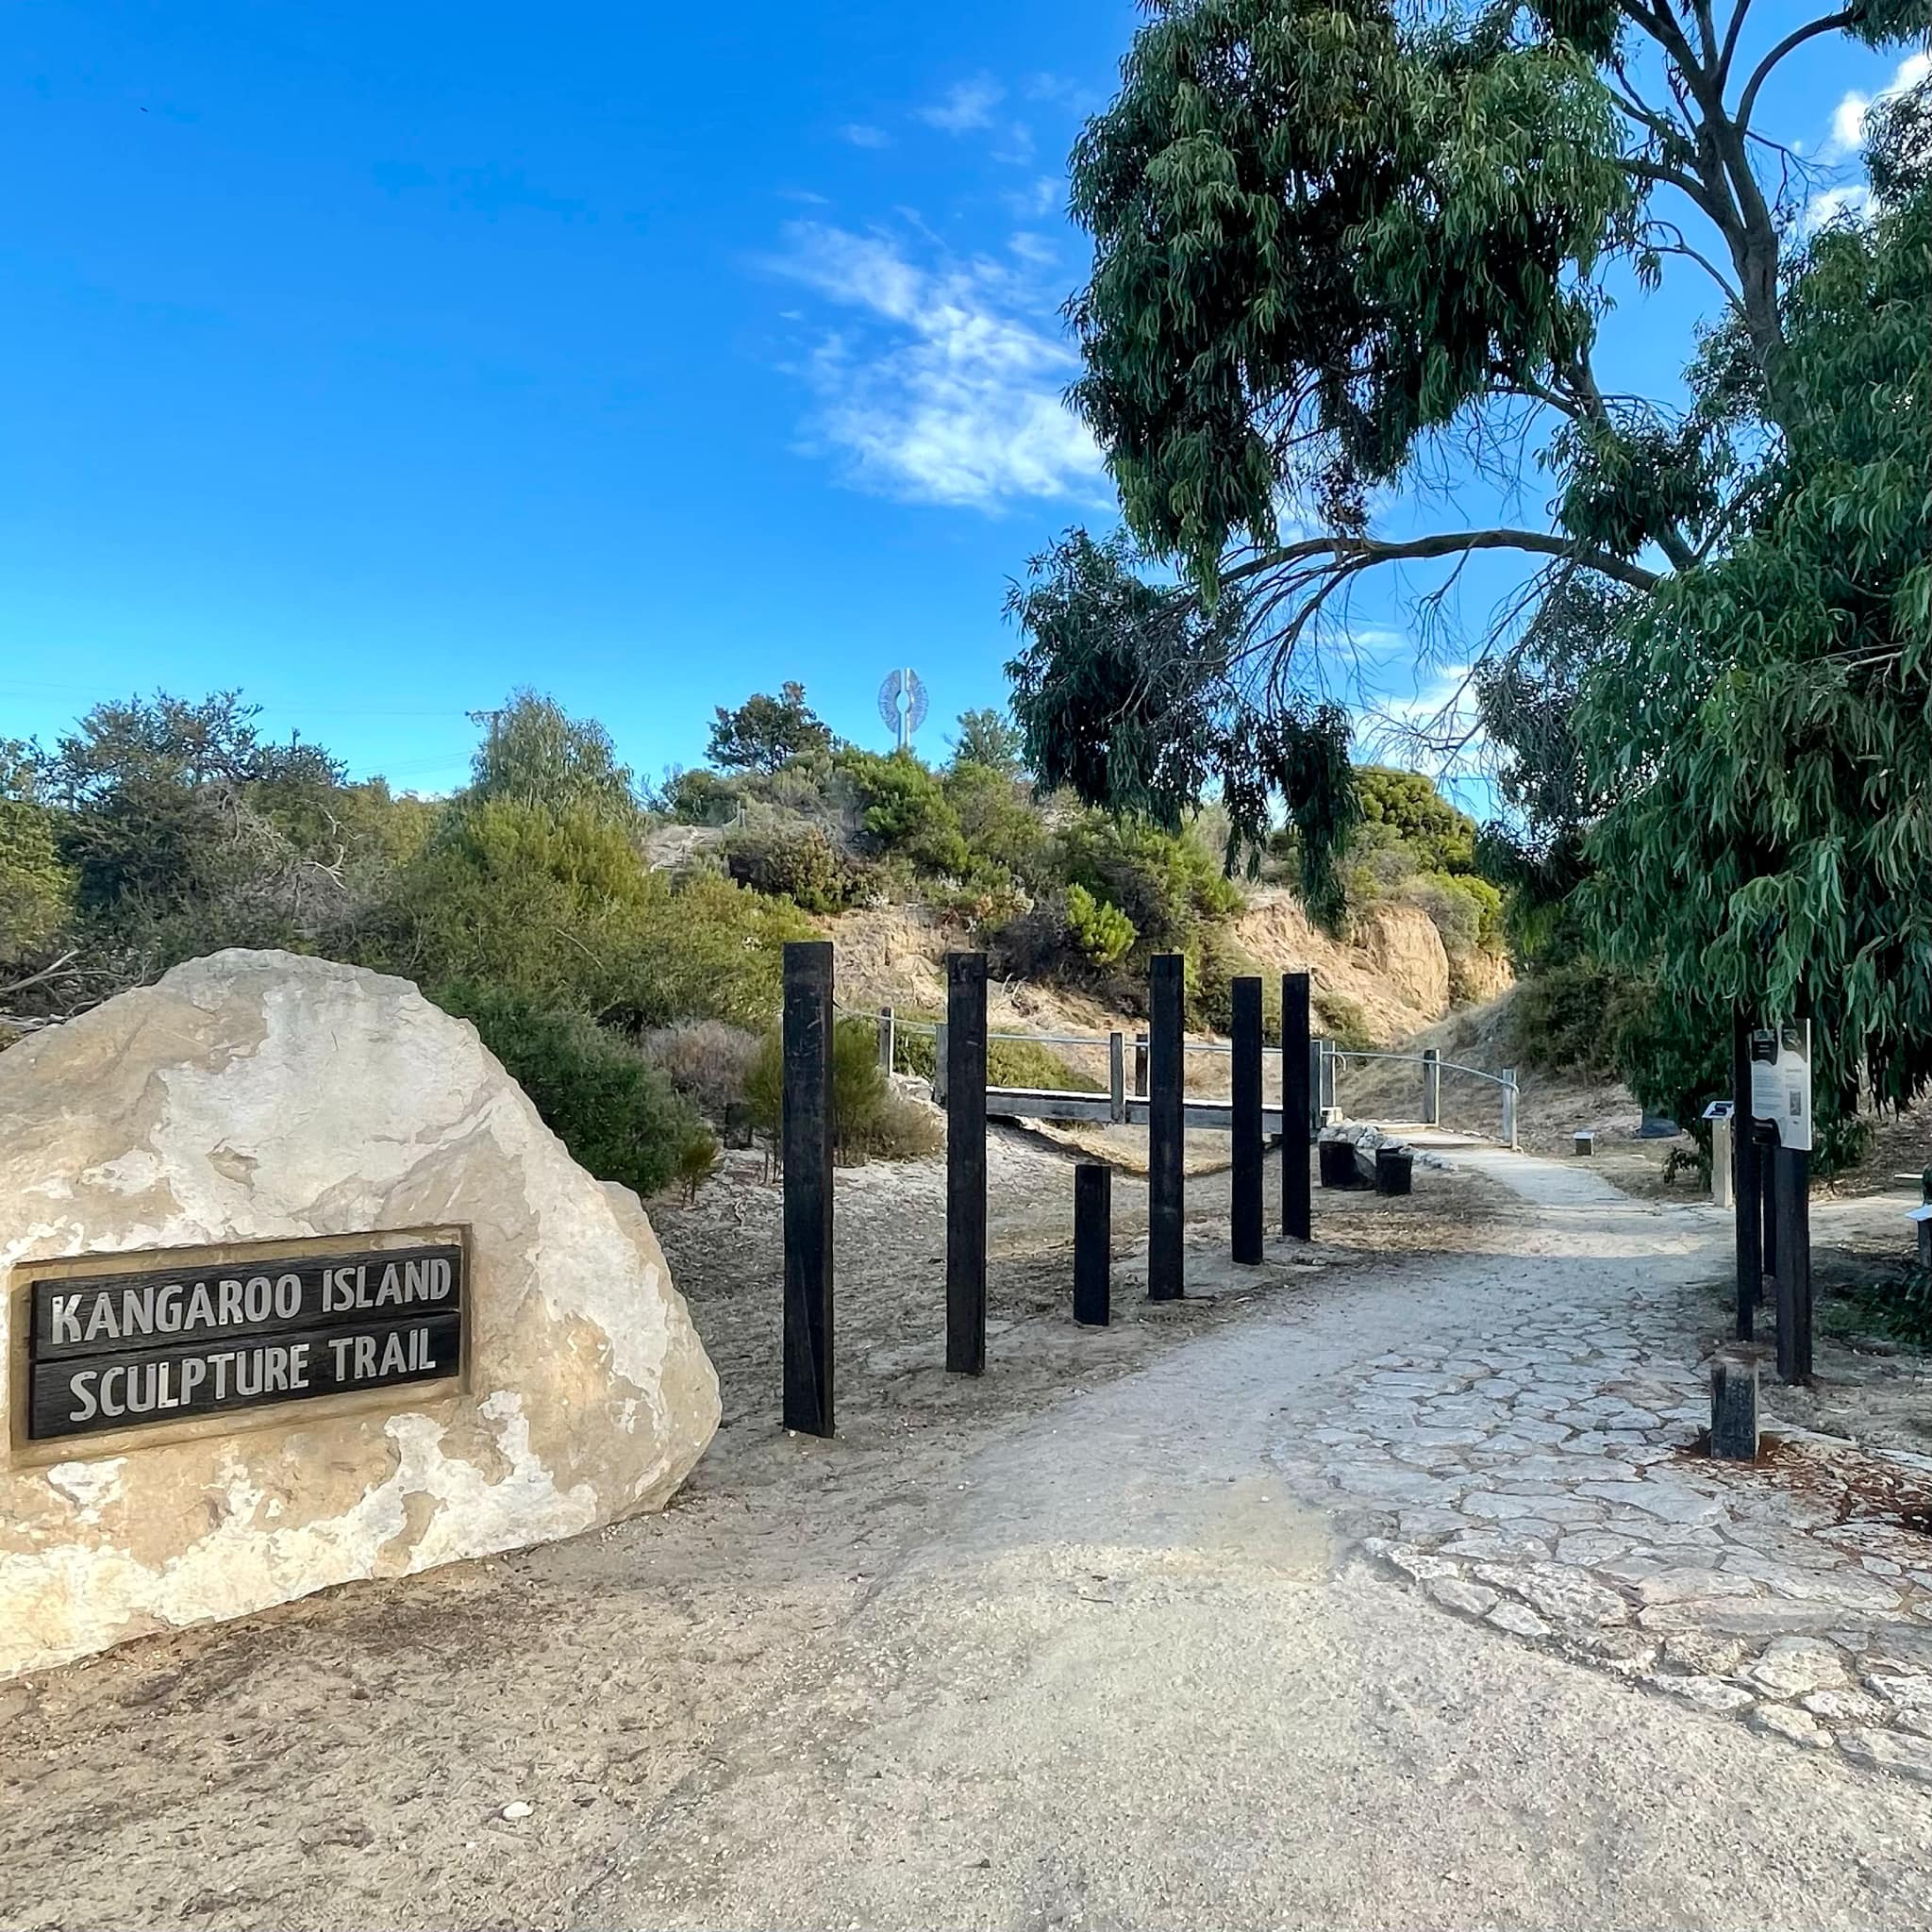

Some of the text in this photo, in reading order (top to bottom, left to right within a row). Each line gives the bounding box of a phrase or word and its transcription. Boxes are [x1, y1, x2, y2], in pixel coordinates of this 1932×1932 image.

[51, 1258, 452, 1345] KANGAROO ISLAND
[69, 1328, 437, 1423] SCULPTURE TRAIL
